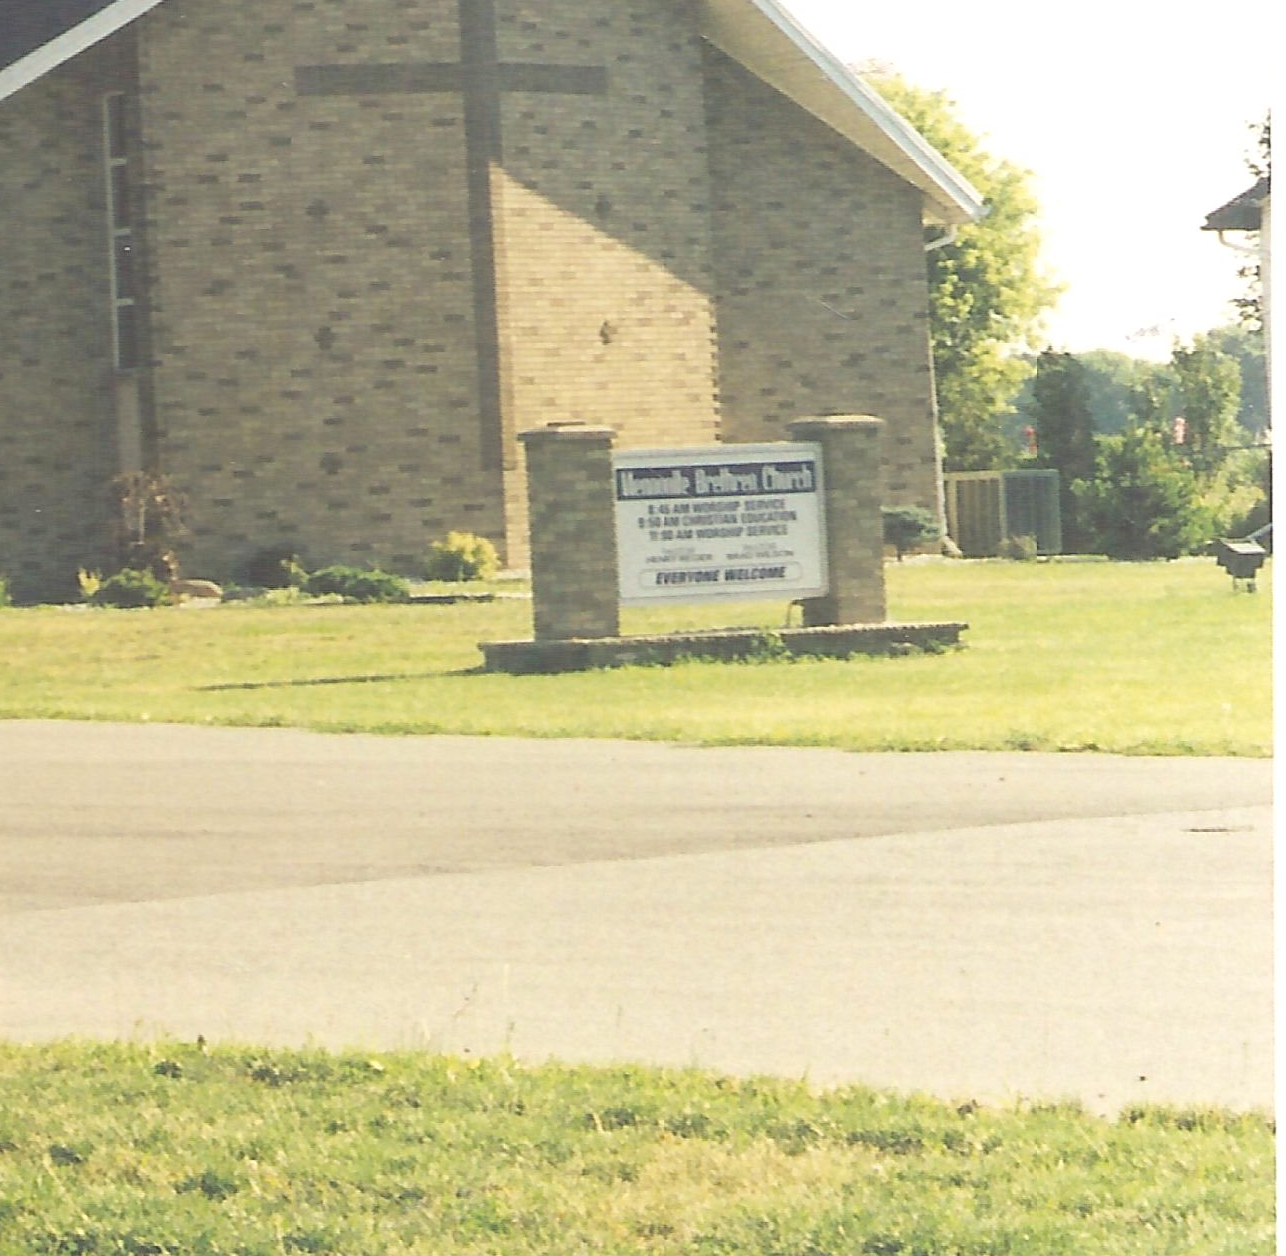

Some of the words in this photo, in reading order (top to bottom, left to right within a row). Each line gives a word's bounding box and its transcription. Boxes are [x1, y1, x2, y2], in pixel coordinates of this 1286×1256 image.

[695, 467, 757, 494] Brethren
[761, 463, 812, 490] Church
[673, 503, 689, 514] AM
[693, 501, 740, 513] WORSHIP
[744, 499, 785, 511] SERVICE
[664, 516, 679, 527] AM
[682, 514, 737, 526] CHRISTIAN
[741, 511, 796, 523] EDUCATION
[677, 529, 693, 539] AM
[696, 527, 743, 539] WORSHIP
[747, 525, 788, 537] SERVICE
[656, 569, 719, 585] EVERYONE
[725, 566, 786, 581] WELCOME
